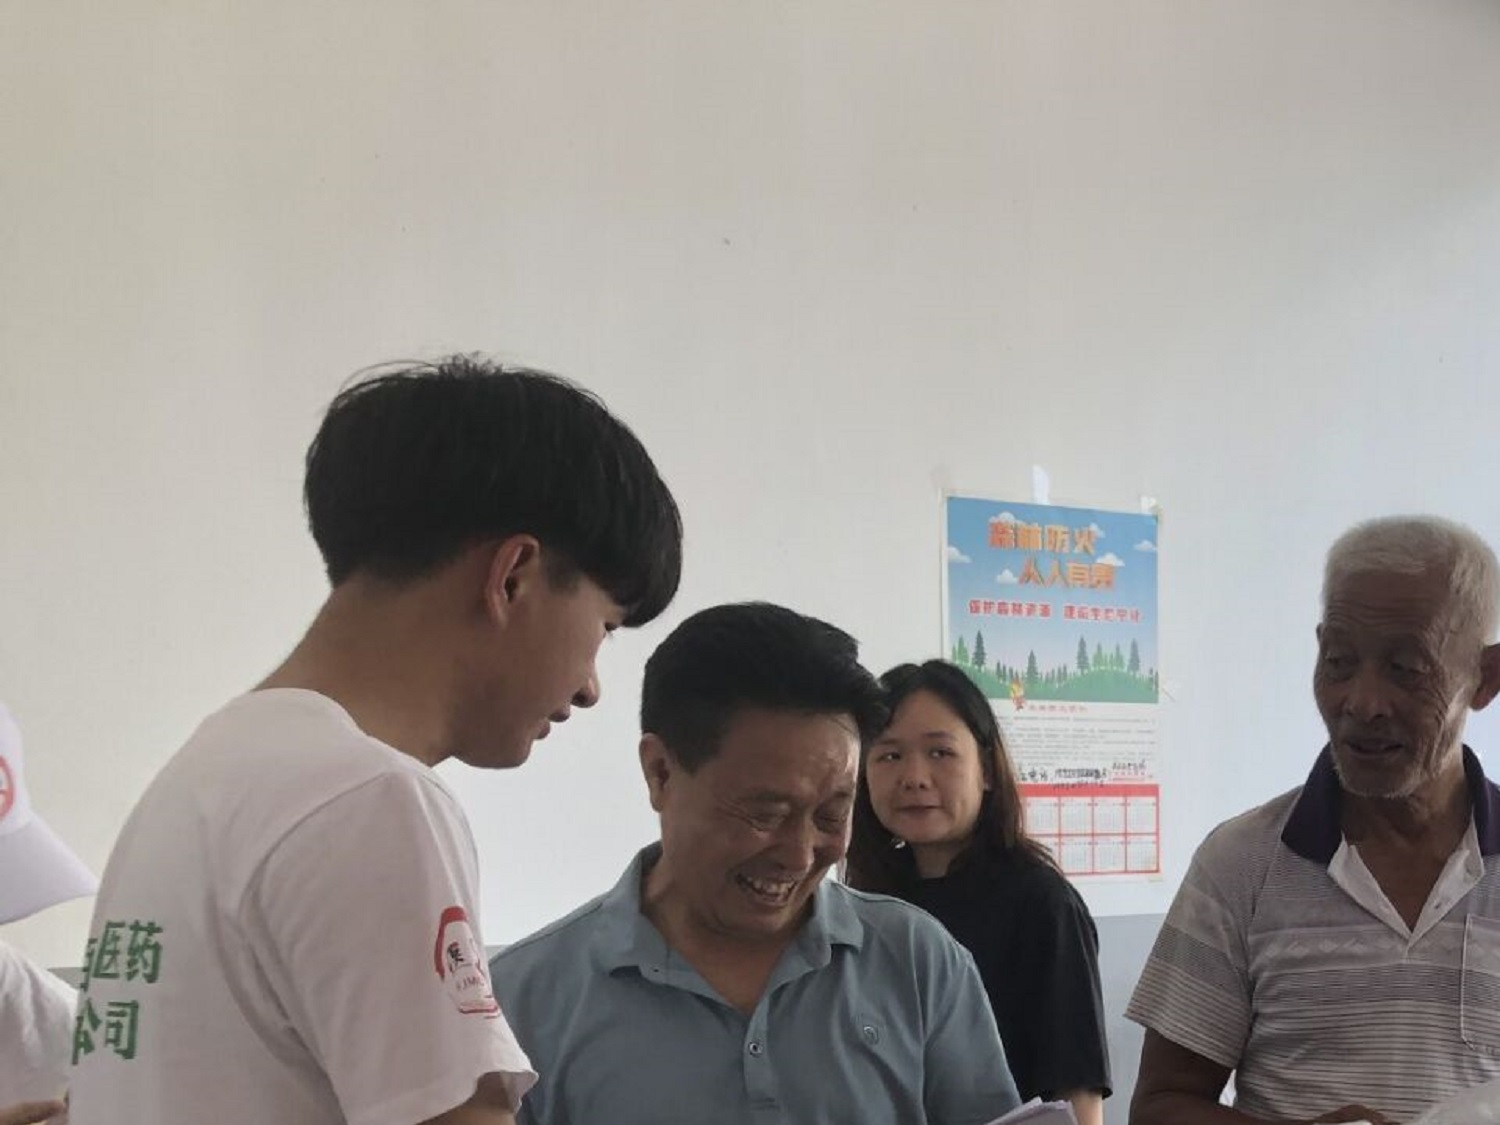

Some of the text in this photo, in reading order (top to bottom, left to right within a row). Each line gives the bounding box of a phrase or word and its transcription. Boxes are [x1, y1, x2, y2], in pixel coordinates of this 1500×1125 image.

[988, 519, 1097, 556] 森林防火
[1018, 556, 1115, 591] 人人有责
